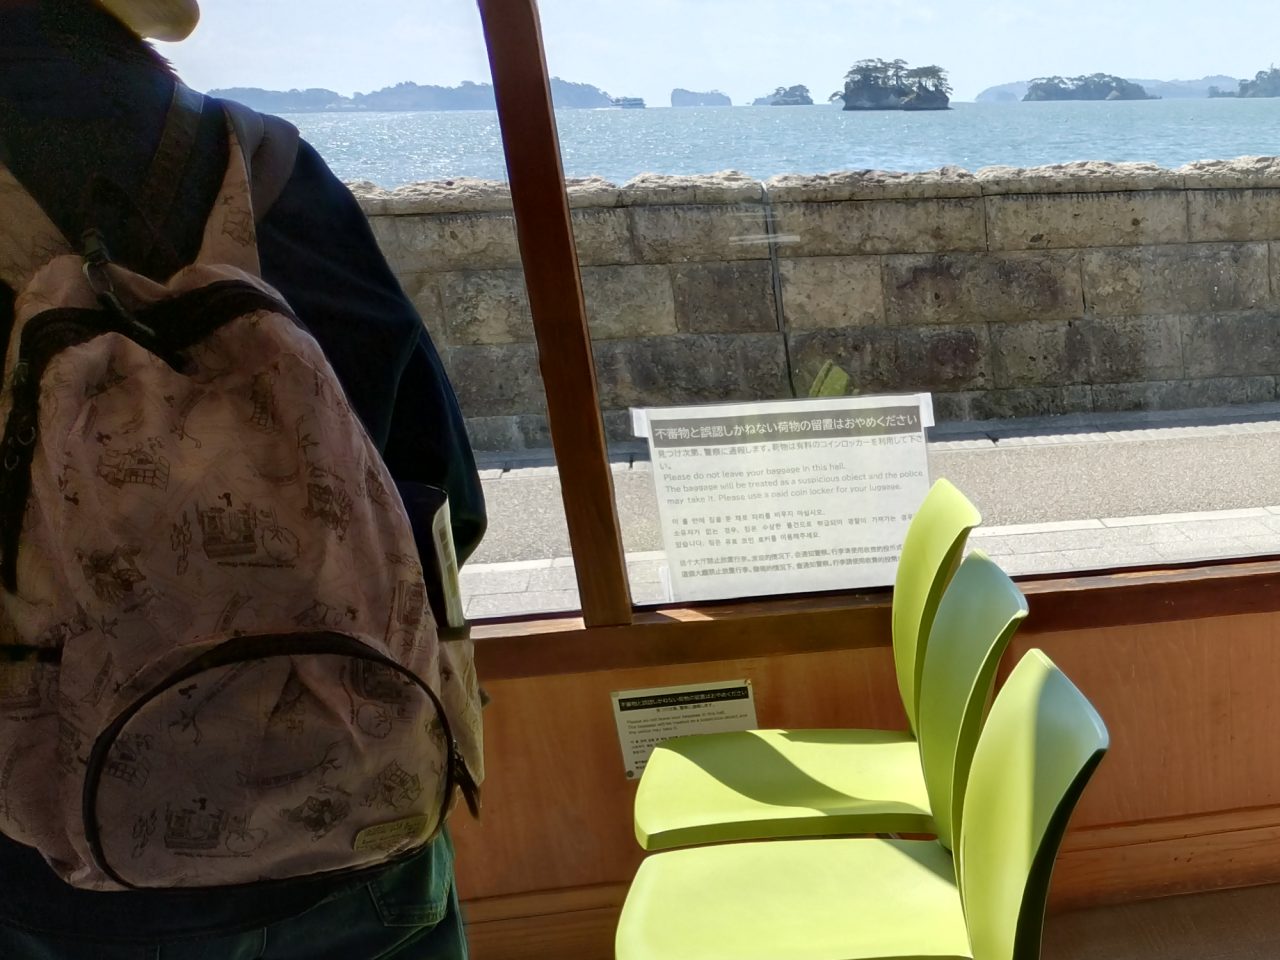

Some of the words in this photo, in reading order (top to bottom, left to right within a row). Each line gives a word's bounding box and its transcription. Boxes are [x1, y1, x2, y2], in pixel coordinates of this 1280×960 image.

[664, 473, 691, 481] Please
[766, 467, 800, 477] baggage
[666, 485, 681, 493] The
[683, 483, 718, 493] baggage
[720, 482, 734, 490] will
[748, 480, 778, 488] treated
[798, 475, 840, 486] suspicious
[841, 473, 866, 482] object
[868, 472, 883, 480] and
[885, 471, 898, 479] the
[899, 470, 923, 479] police
[687, 496, 705, 504] take
[718, 494, 745, 502] Please
[771, 491, 789, 500] paid
[809, 487, 834, 496] locker
[850, 487, 867, 495] your
